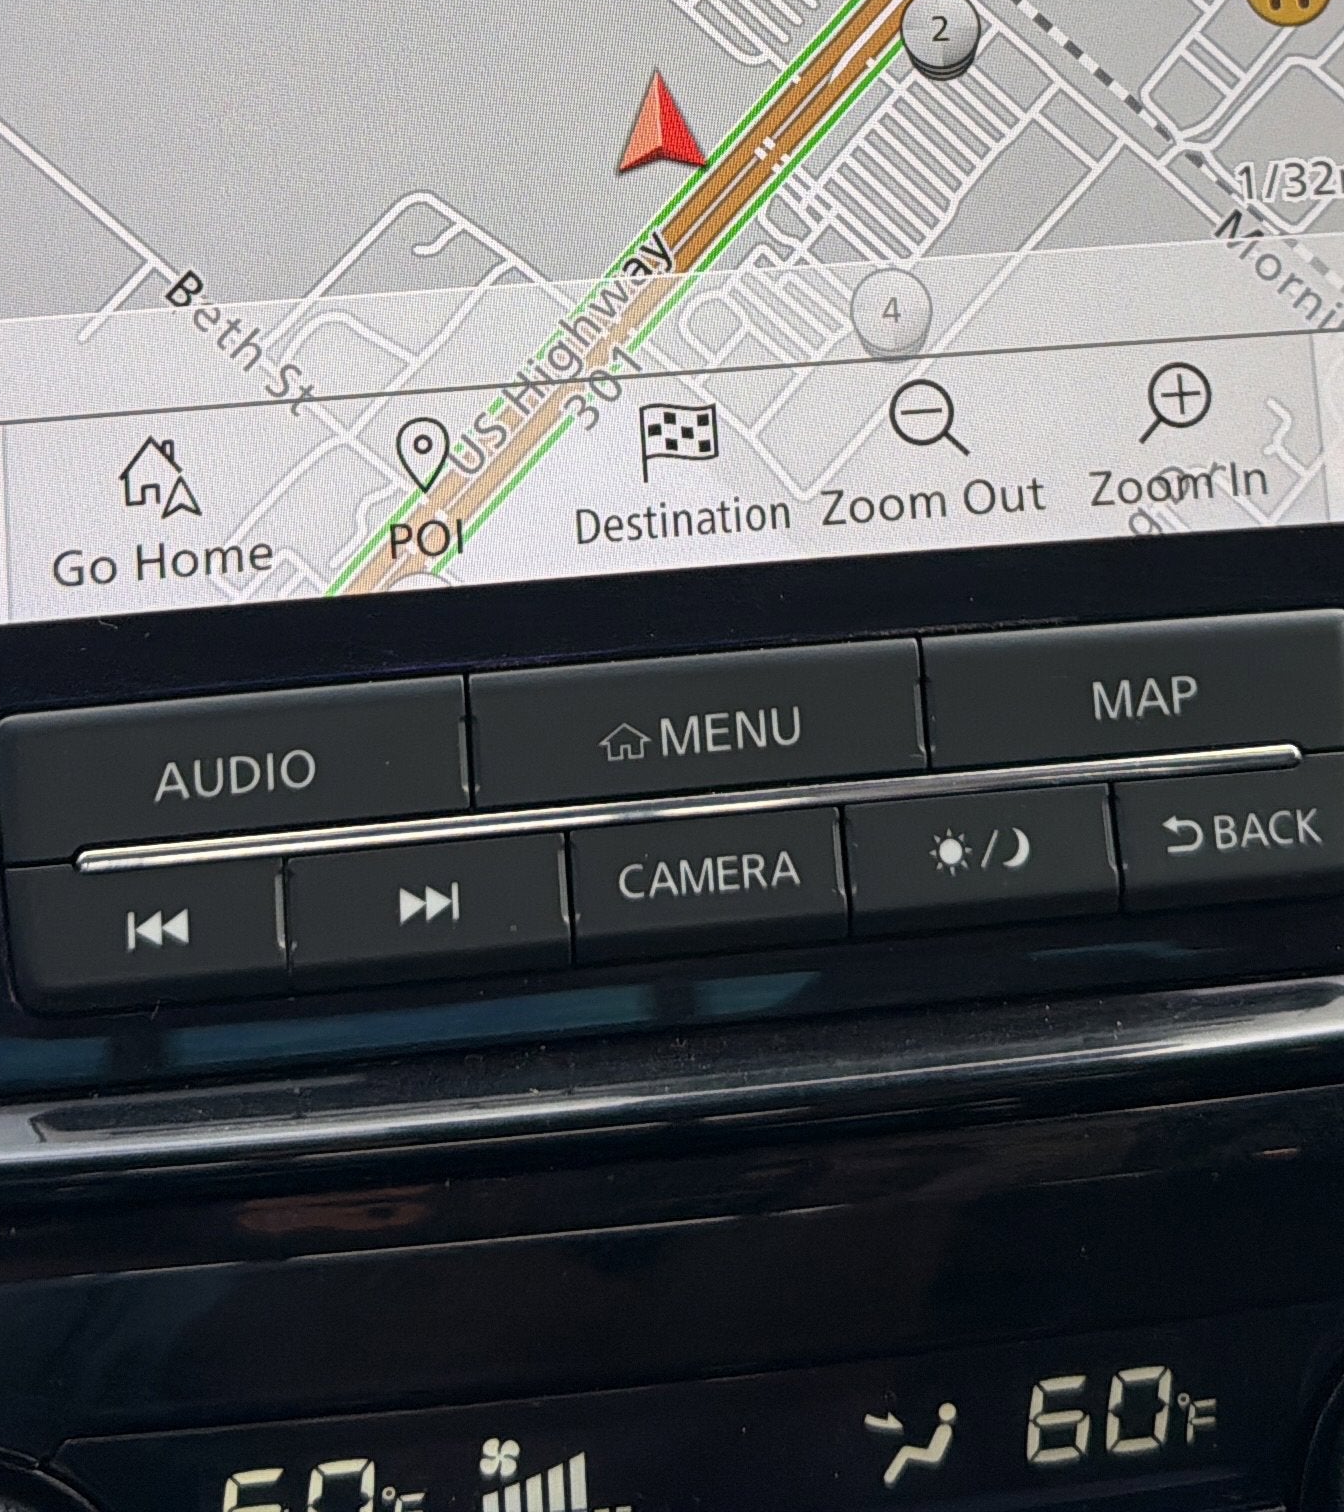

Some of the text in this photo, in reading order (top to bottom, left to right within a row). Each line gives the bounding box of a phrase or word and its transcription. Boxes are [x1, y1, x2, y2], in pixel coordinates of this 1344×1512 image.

[931, 15, 949, 43] 2
[882, 298, 901, 325] 4
[164, 269, 316, 418] Beth St
[447, 231, 675, 476] US Highway
[562, 346, 646, 433] 301
[821, 477, 1047, 527] Zoom Out
[1089, 459, 1269, 508] Zoom In
[389, 517, 466, 560] POI
[575, 496, 793, 546] Destination
[54, 541, 274, 588] Go Home
[1091, 675, 1199, 724] MAP
[660, 705, 804, 759] MENU
[154, 747, 317, 804] AUDIO
[1213, 808, 1324, 852] BACK
[616, 849, 801, 903] CAMERA
